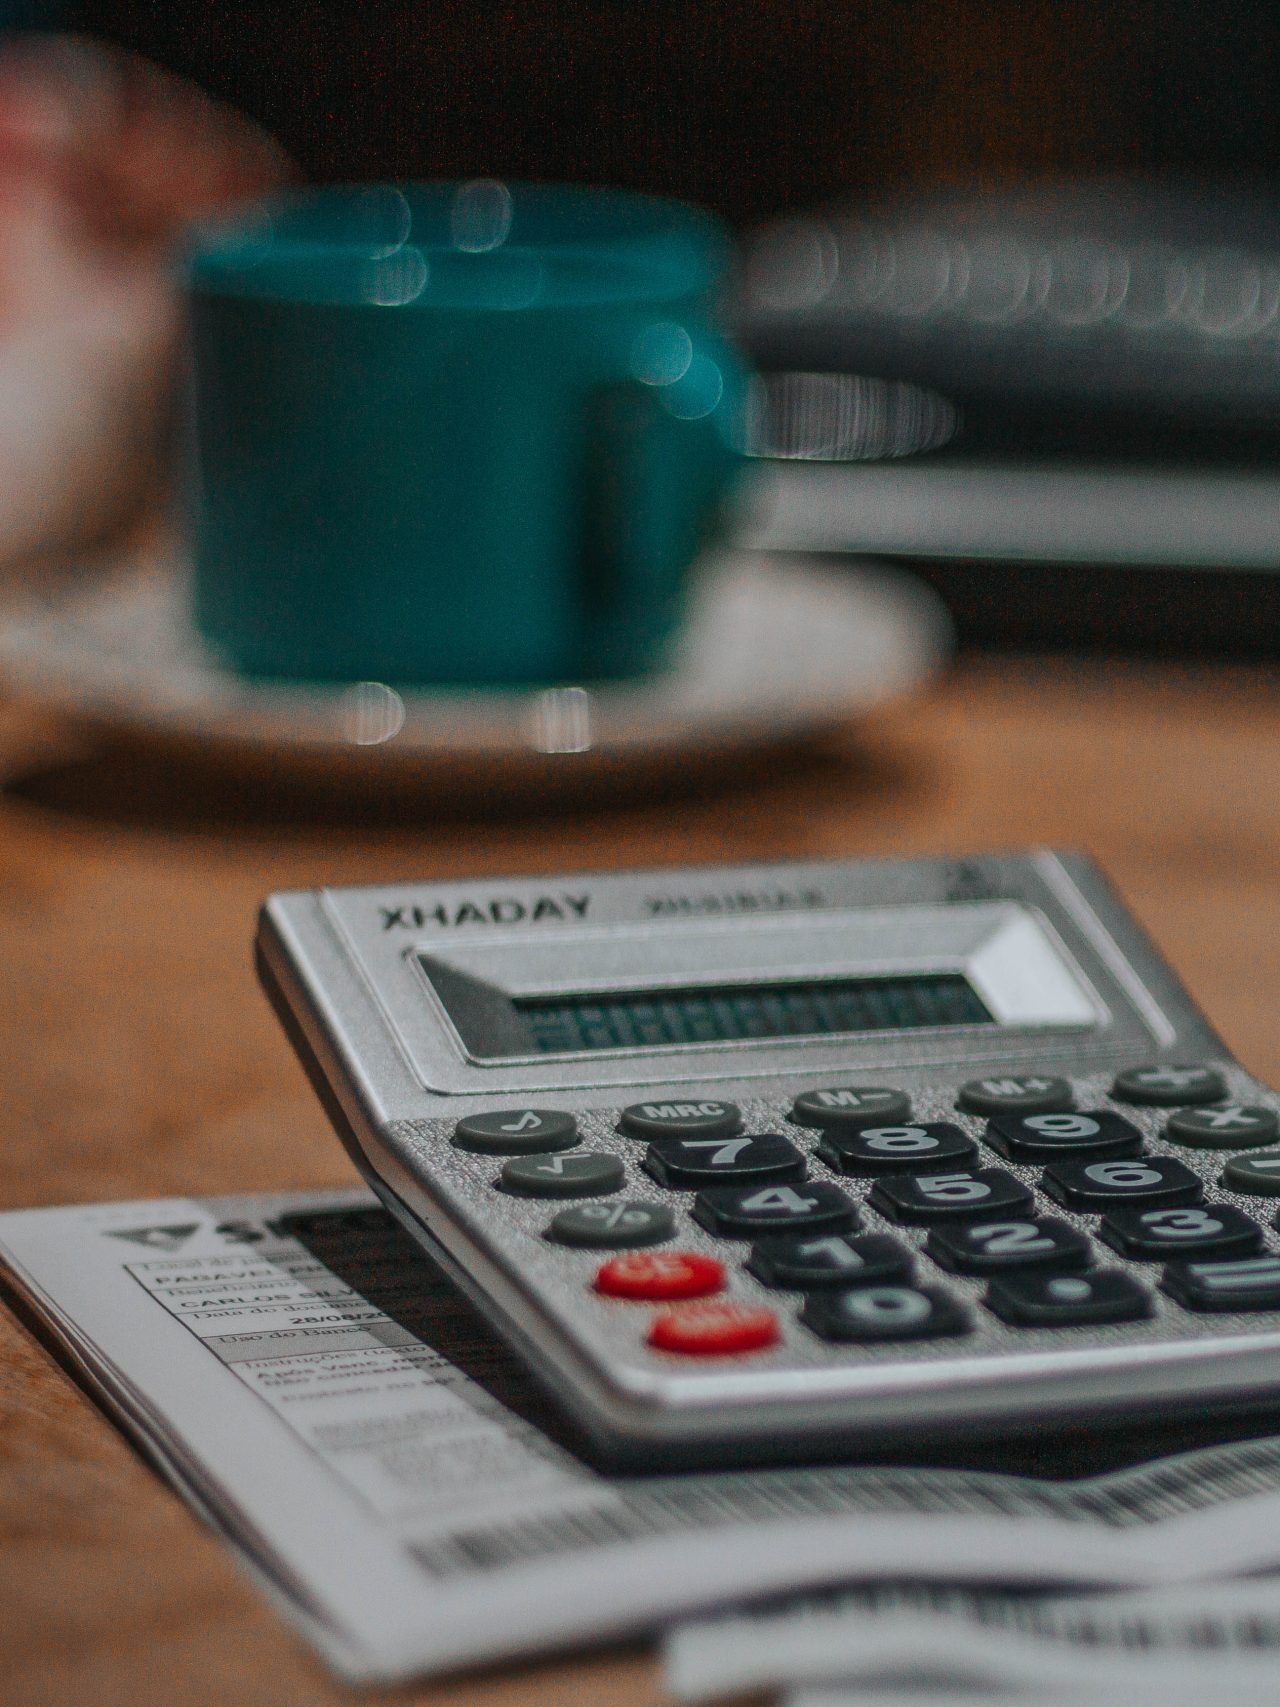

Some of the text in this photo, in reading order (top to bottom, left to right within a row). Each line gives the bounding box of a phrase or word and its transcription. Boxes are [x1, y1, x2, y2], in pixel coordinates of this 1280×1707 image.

[380, 896, 592, 931] XHADAY
[980, 1077, 1052, 1096] M+
[642, 1102, 725, 1118] MRC
[859, 1126, 940, 1151] 8
[1022, 1113, 1101, 1138] 9
[681, 1137, 754, 1164] 7
[915, 1173, 992, 1201] 5
[1084, 1161, 1163, 1188] 6
[741, 1186, 819, 1214] 4
[581, 1202, 651, 1229] %
[1140, 1208, 1224, 1237] 3
[968, 1222, 1056, 1254] 2
[800, 1236, 866, 1268] 1
[180, 1293, 291, 1309] CARLOS
[194, 1309, 243, 1320] Data
[843, 1286, 934, 1325] 0
[289, 1311, 390, 1325] 28/08/20
[218, 1325, 372, 1345] Uso do Banco
